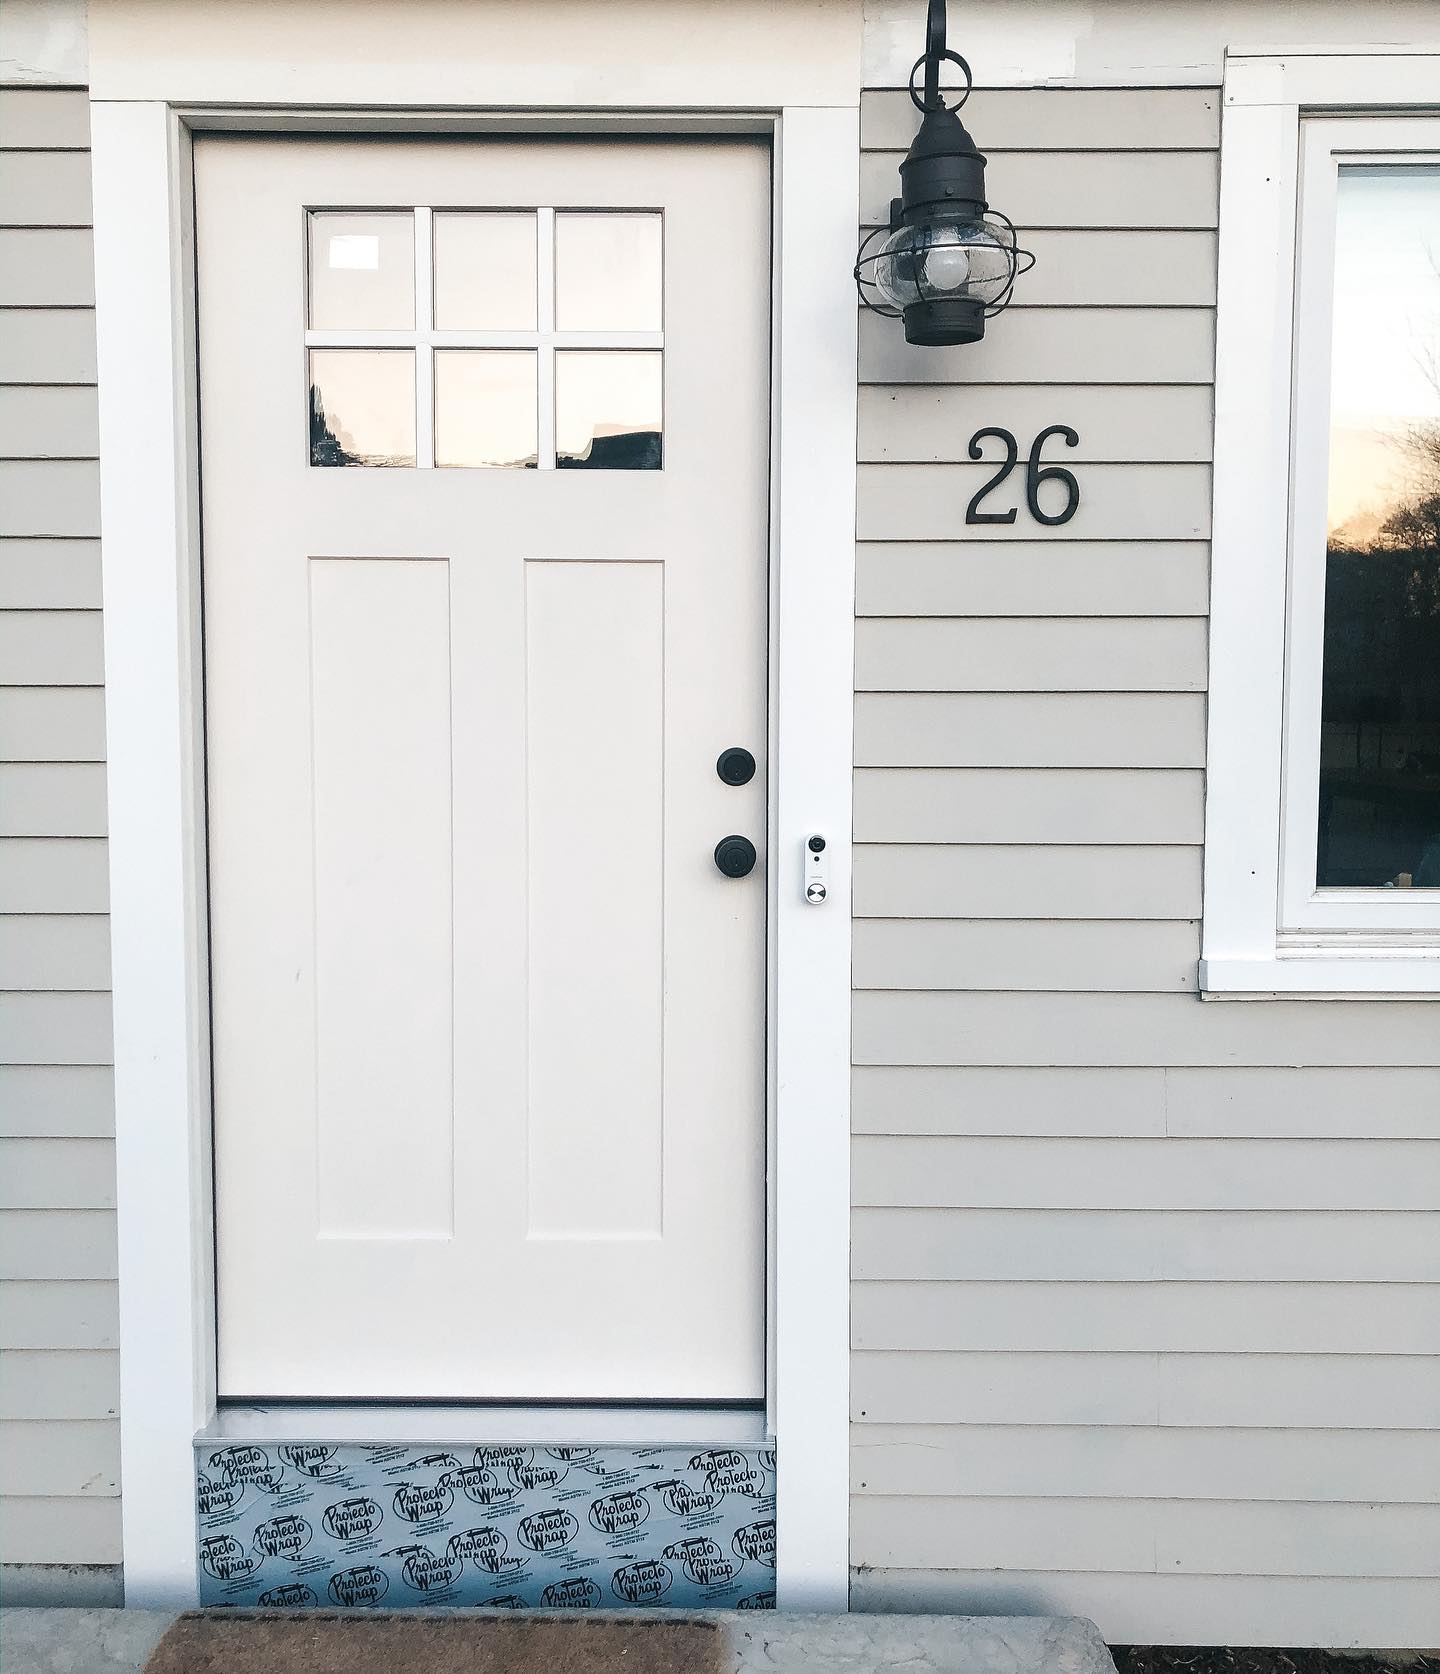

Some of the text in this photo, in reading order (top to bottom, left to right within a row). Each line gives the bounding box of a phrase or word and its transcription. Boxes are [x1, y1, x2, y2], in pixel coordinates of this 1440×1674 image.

[966, 425, 1079, 525] 26
[406, 1501, 443, 1522] Wrap
[676, 1494, 714, 1516] Wrap
[335, 1519, 372, 1540] Wrap
[601, 1512, 639, 1533] Wrap
[264, 1536, 301, 1556] Wrap
[530, 1529, 567, 1551] Wrap
[216, 1558, 253, 1580] Wrap
[695, 1565, 732, 1585] Wrap
[415, 1569, 452, 1591] Wrap
[340, 1586, 378, 1607] Wrap
[625, 1581, 662, 1602] Wrap
